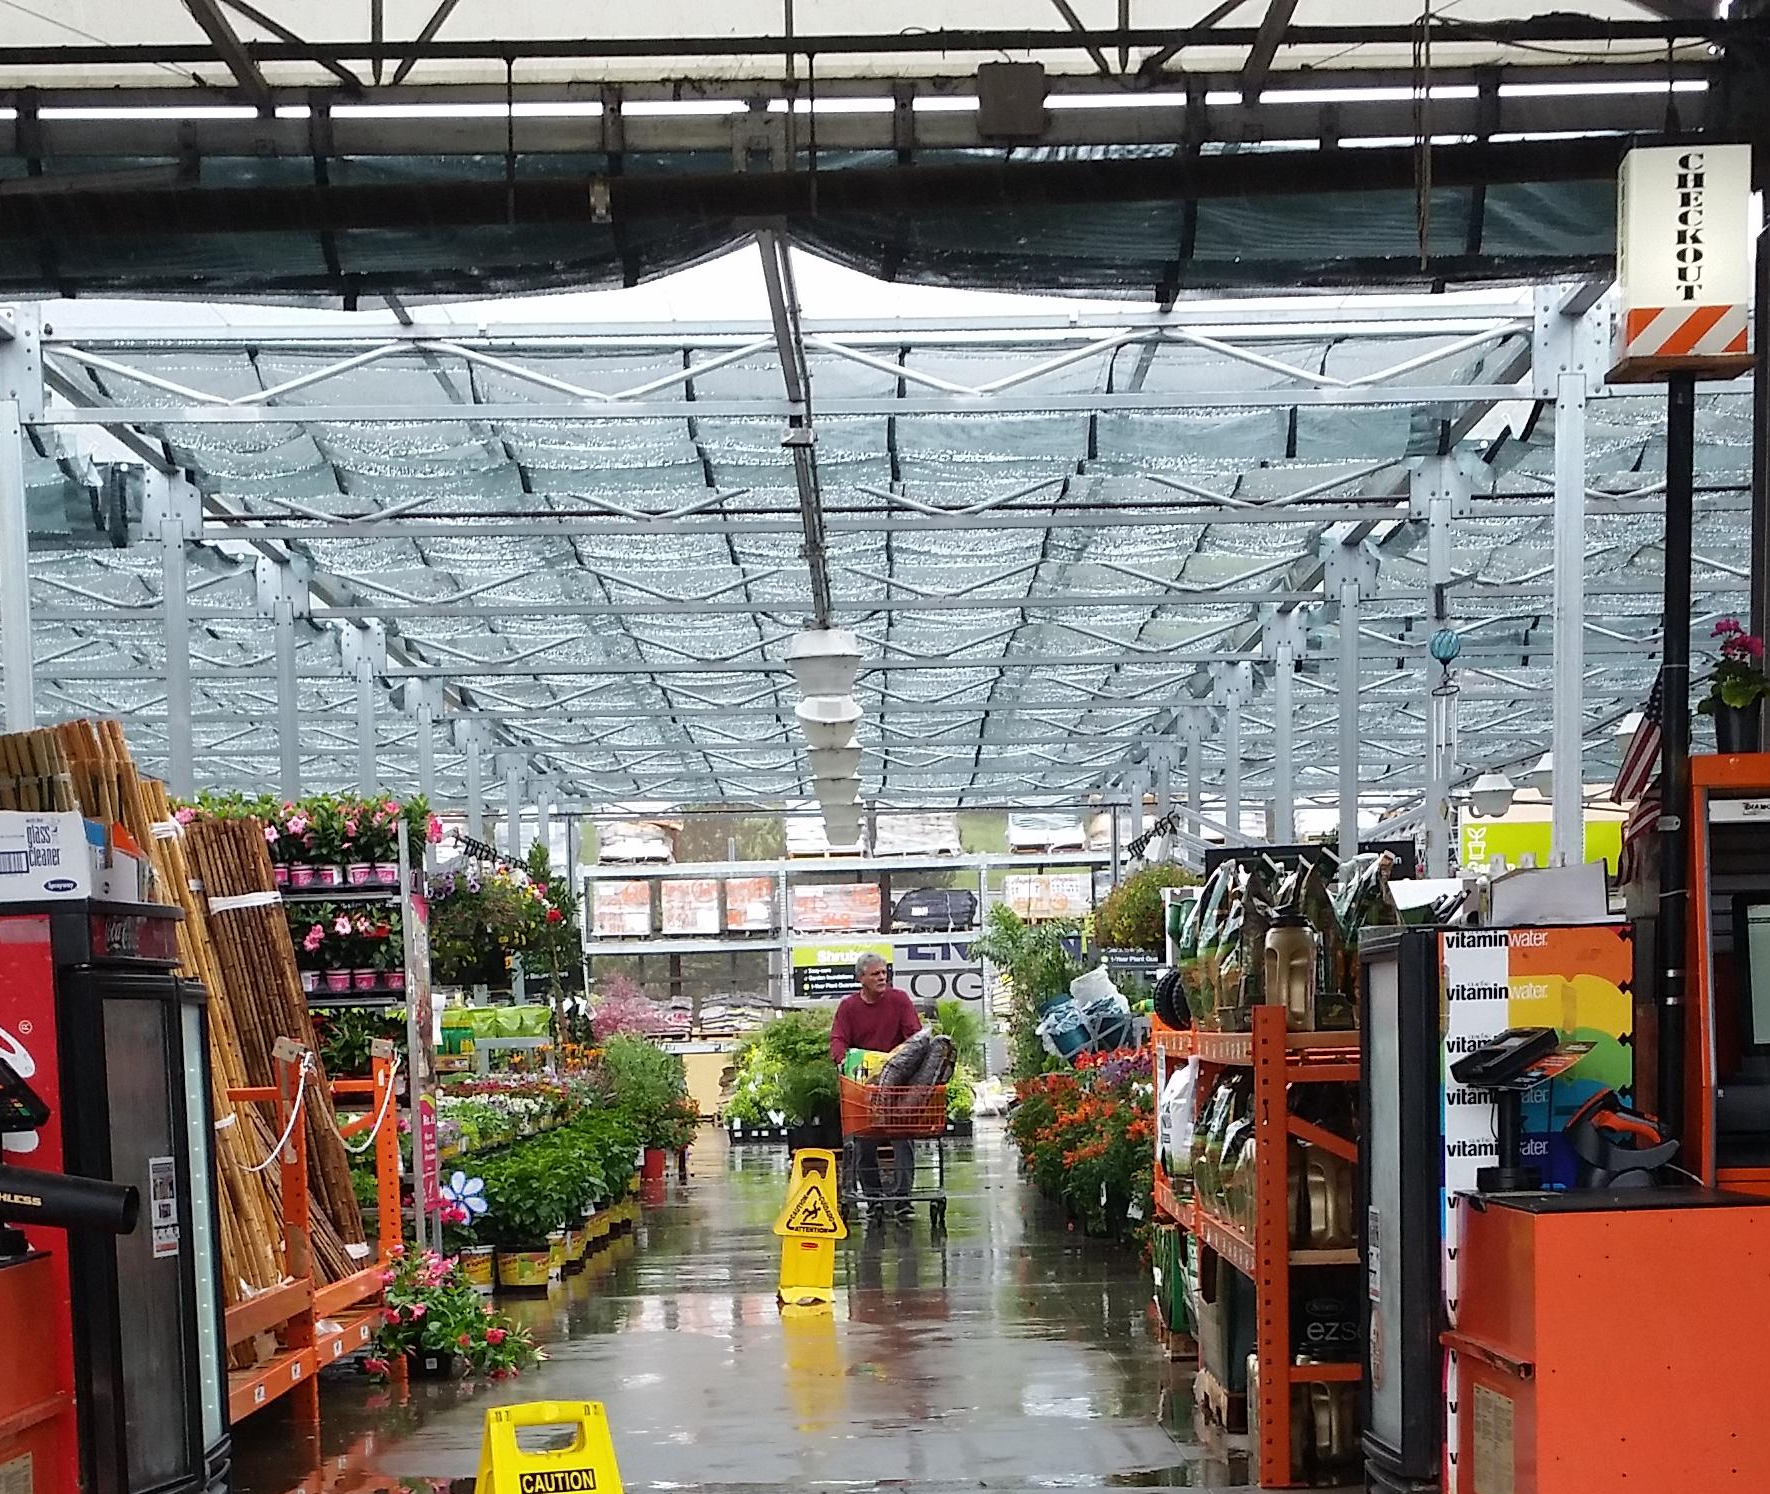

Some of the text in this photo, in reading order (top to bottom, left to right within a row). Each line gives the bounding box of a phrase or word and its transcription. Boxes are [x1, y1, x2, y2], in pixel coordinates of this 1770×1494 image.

[1676, 153, 1706, 301] CHECKOUT
[26, 824, 51, 848] glass
[29, 848, 61, 868] cleaner
[521, 1470, 595, 1493] CAUTION
